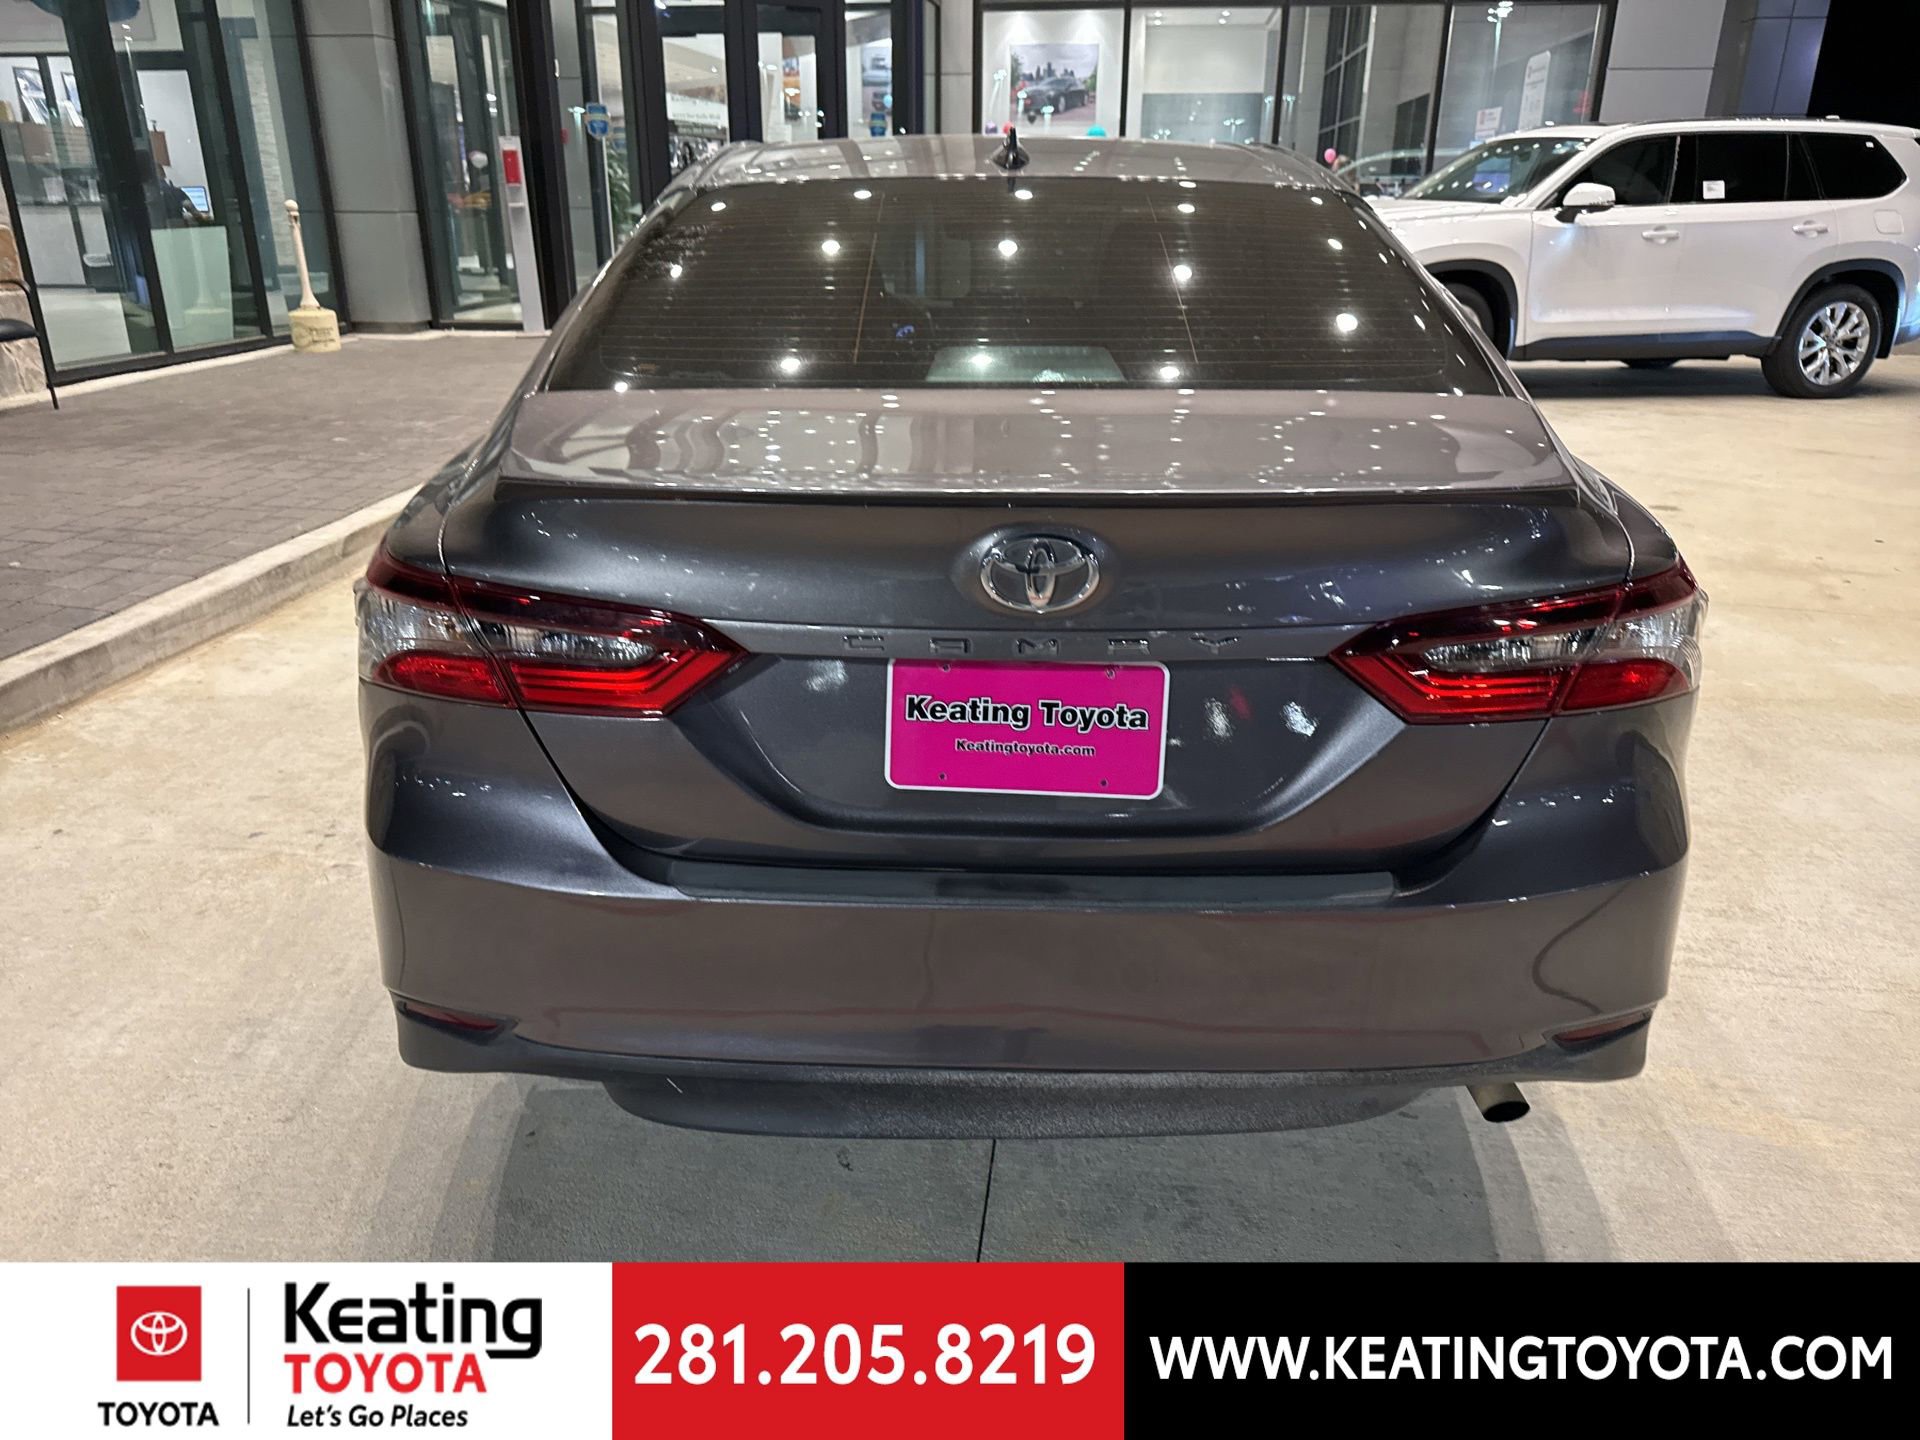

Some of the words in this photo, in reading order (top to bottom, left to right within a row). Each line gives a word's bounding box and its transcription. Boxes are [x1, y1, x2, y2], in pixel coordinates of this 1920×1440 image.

[843, 633, 1240, 655] CAMRY
[905, 695, 1030, 731] Keating
[1038, 700, 1150, 734] Toyota
[954, 738, 1096, 758] Keatingtoyota.com
